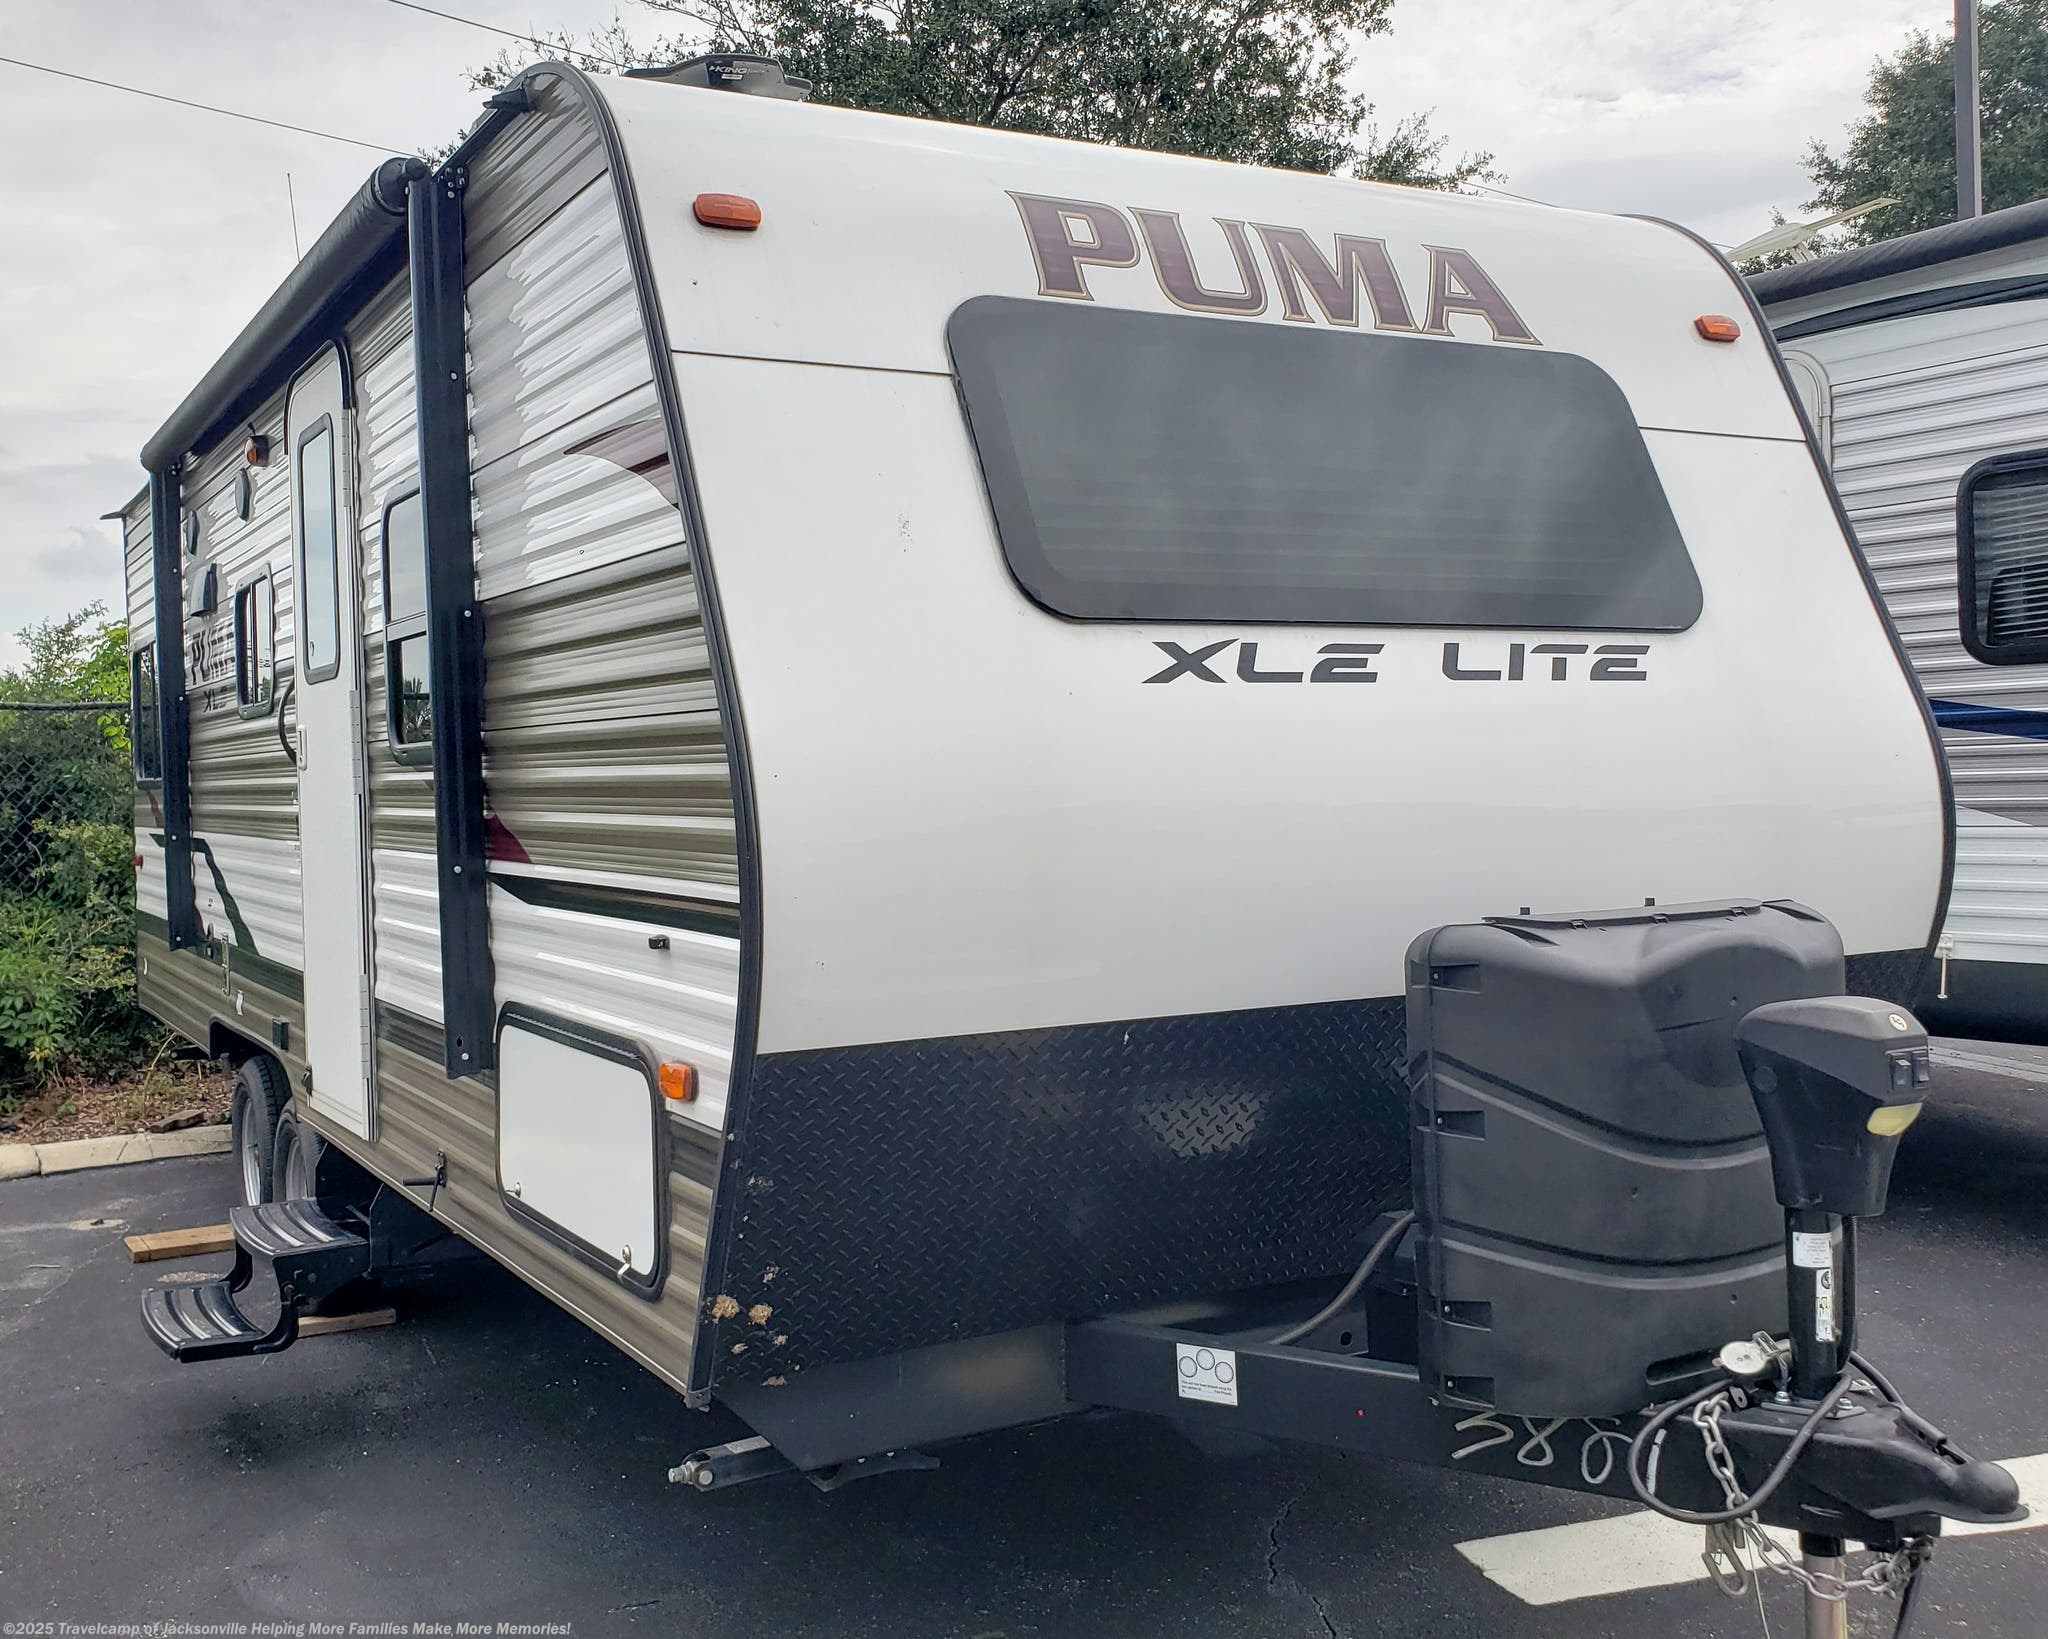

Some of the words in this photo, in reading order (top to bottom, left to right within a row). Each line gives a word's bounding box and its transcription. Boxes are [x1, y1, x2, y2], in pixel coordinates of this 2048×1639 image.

[1003, 190, 1543, 346] PUMA
[1141, 638, 1385, 684] XLE
[1442, 642, 1651, 682] LITE
